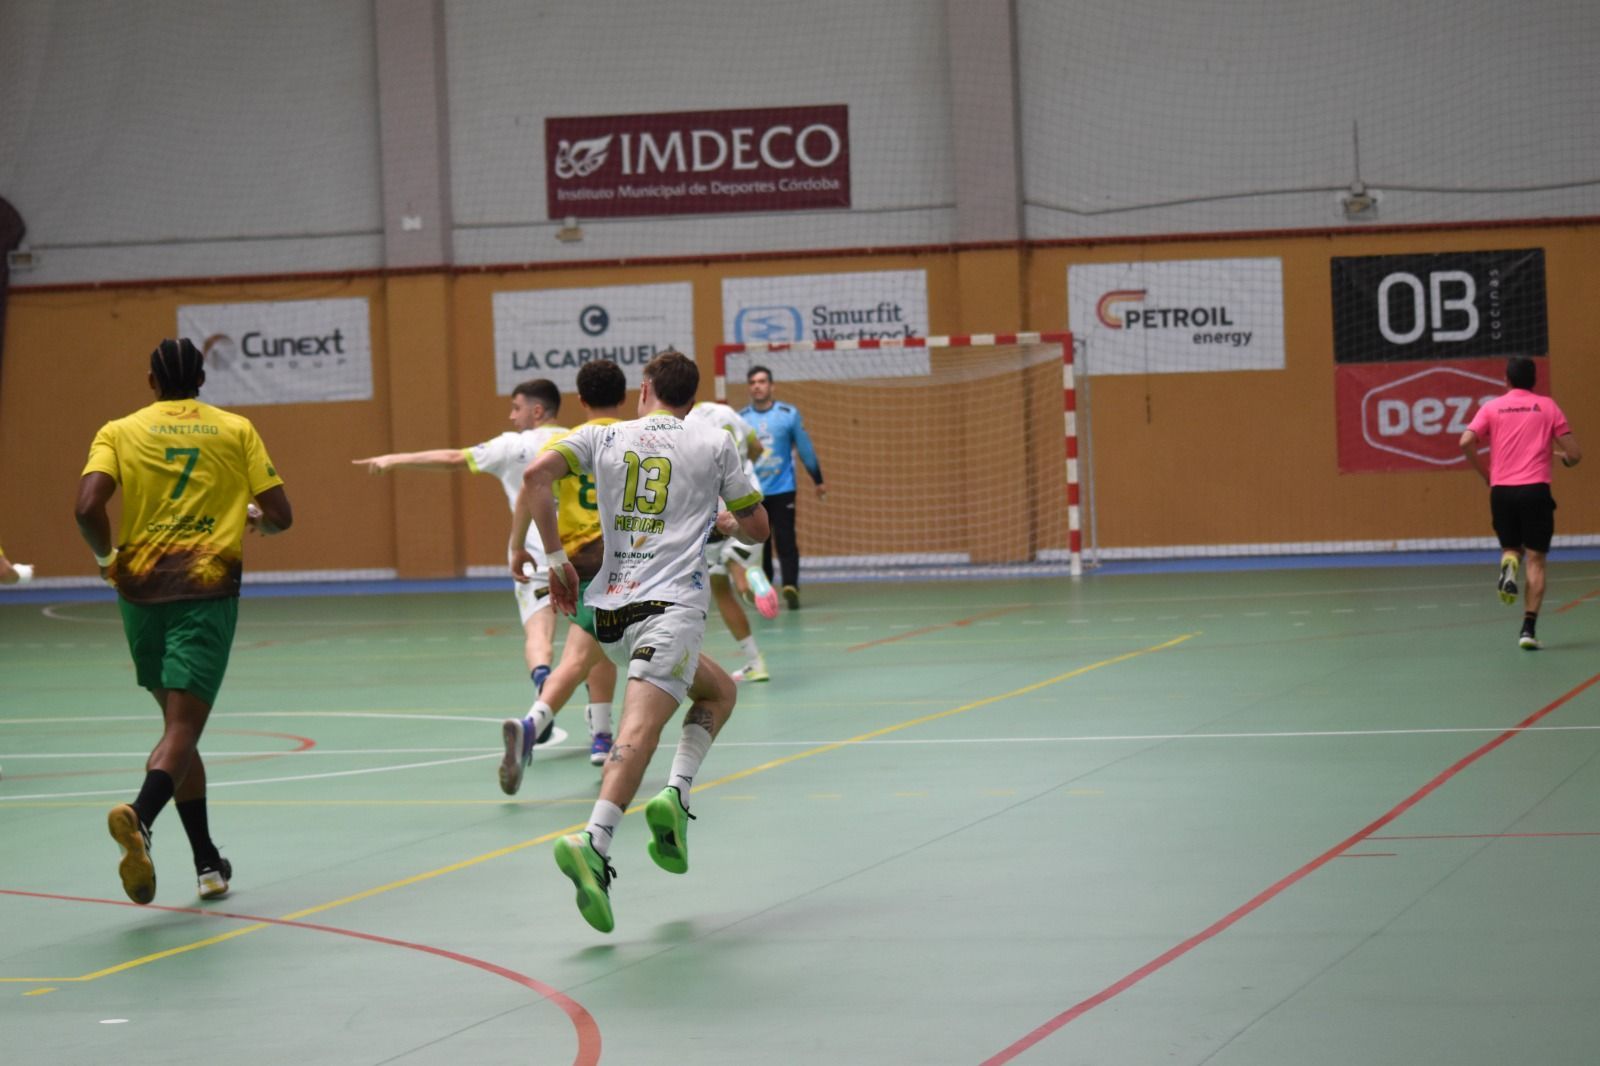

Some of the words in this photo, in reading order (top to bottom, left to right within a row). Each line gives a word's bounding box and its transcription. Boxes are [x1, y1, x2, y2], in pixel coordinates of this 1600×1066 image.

[620, 124, 841, 175] IMDECO
[557, 187, 614, 200] Instituto
[617, 184, 686, 199] Municipal
[688, 182, 707, 195] de
[711, 180, 776, 197] Deportes
[778, 177, 840, 193] Córdoba
[812, 303, 902, 326] Smurfit
[1377, 270, 1480, 344] OB
[1489, 269, 1502, 340] cocinas
[1125, 306, 1234, 330] PETROIL
[241, 328, 344, 358] Cunext
[1193, 331, 1252, 347] energy
[511, 351, 541, 371] LA
[151, 423, 219, 436] SANTIAGO
[165, 447, 200, 500] 7
[622, 450, 672, 515] 13
[614, 514, 665, 534] MEDINA
